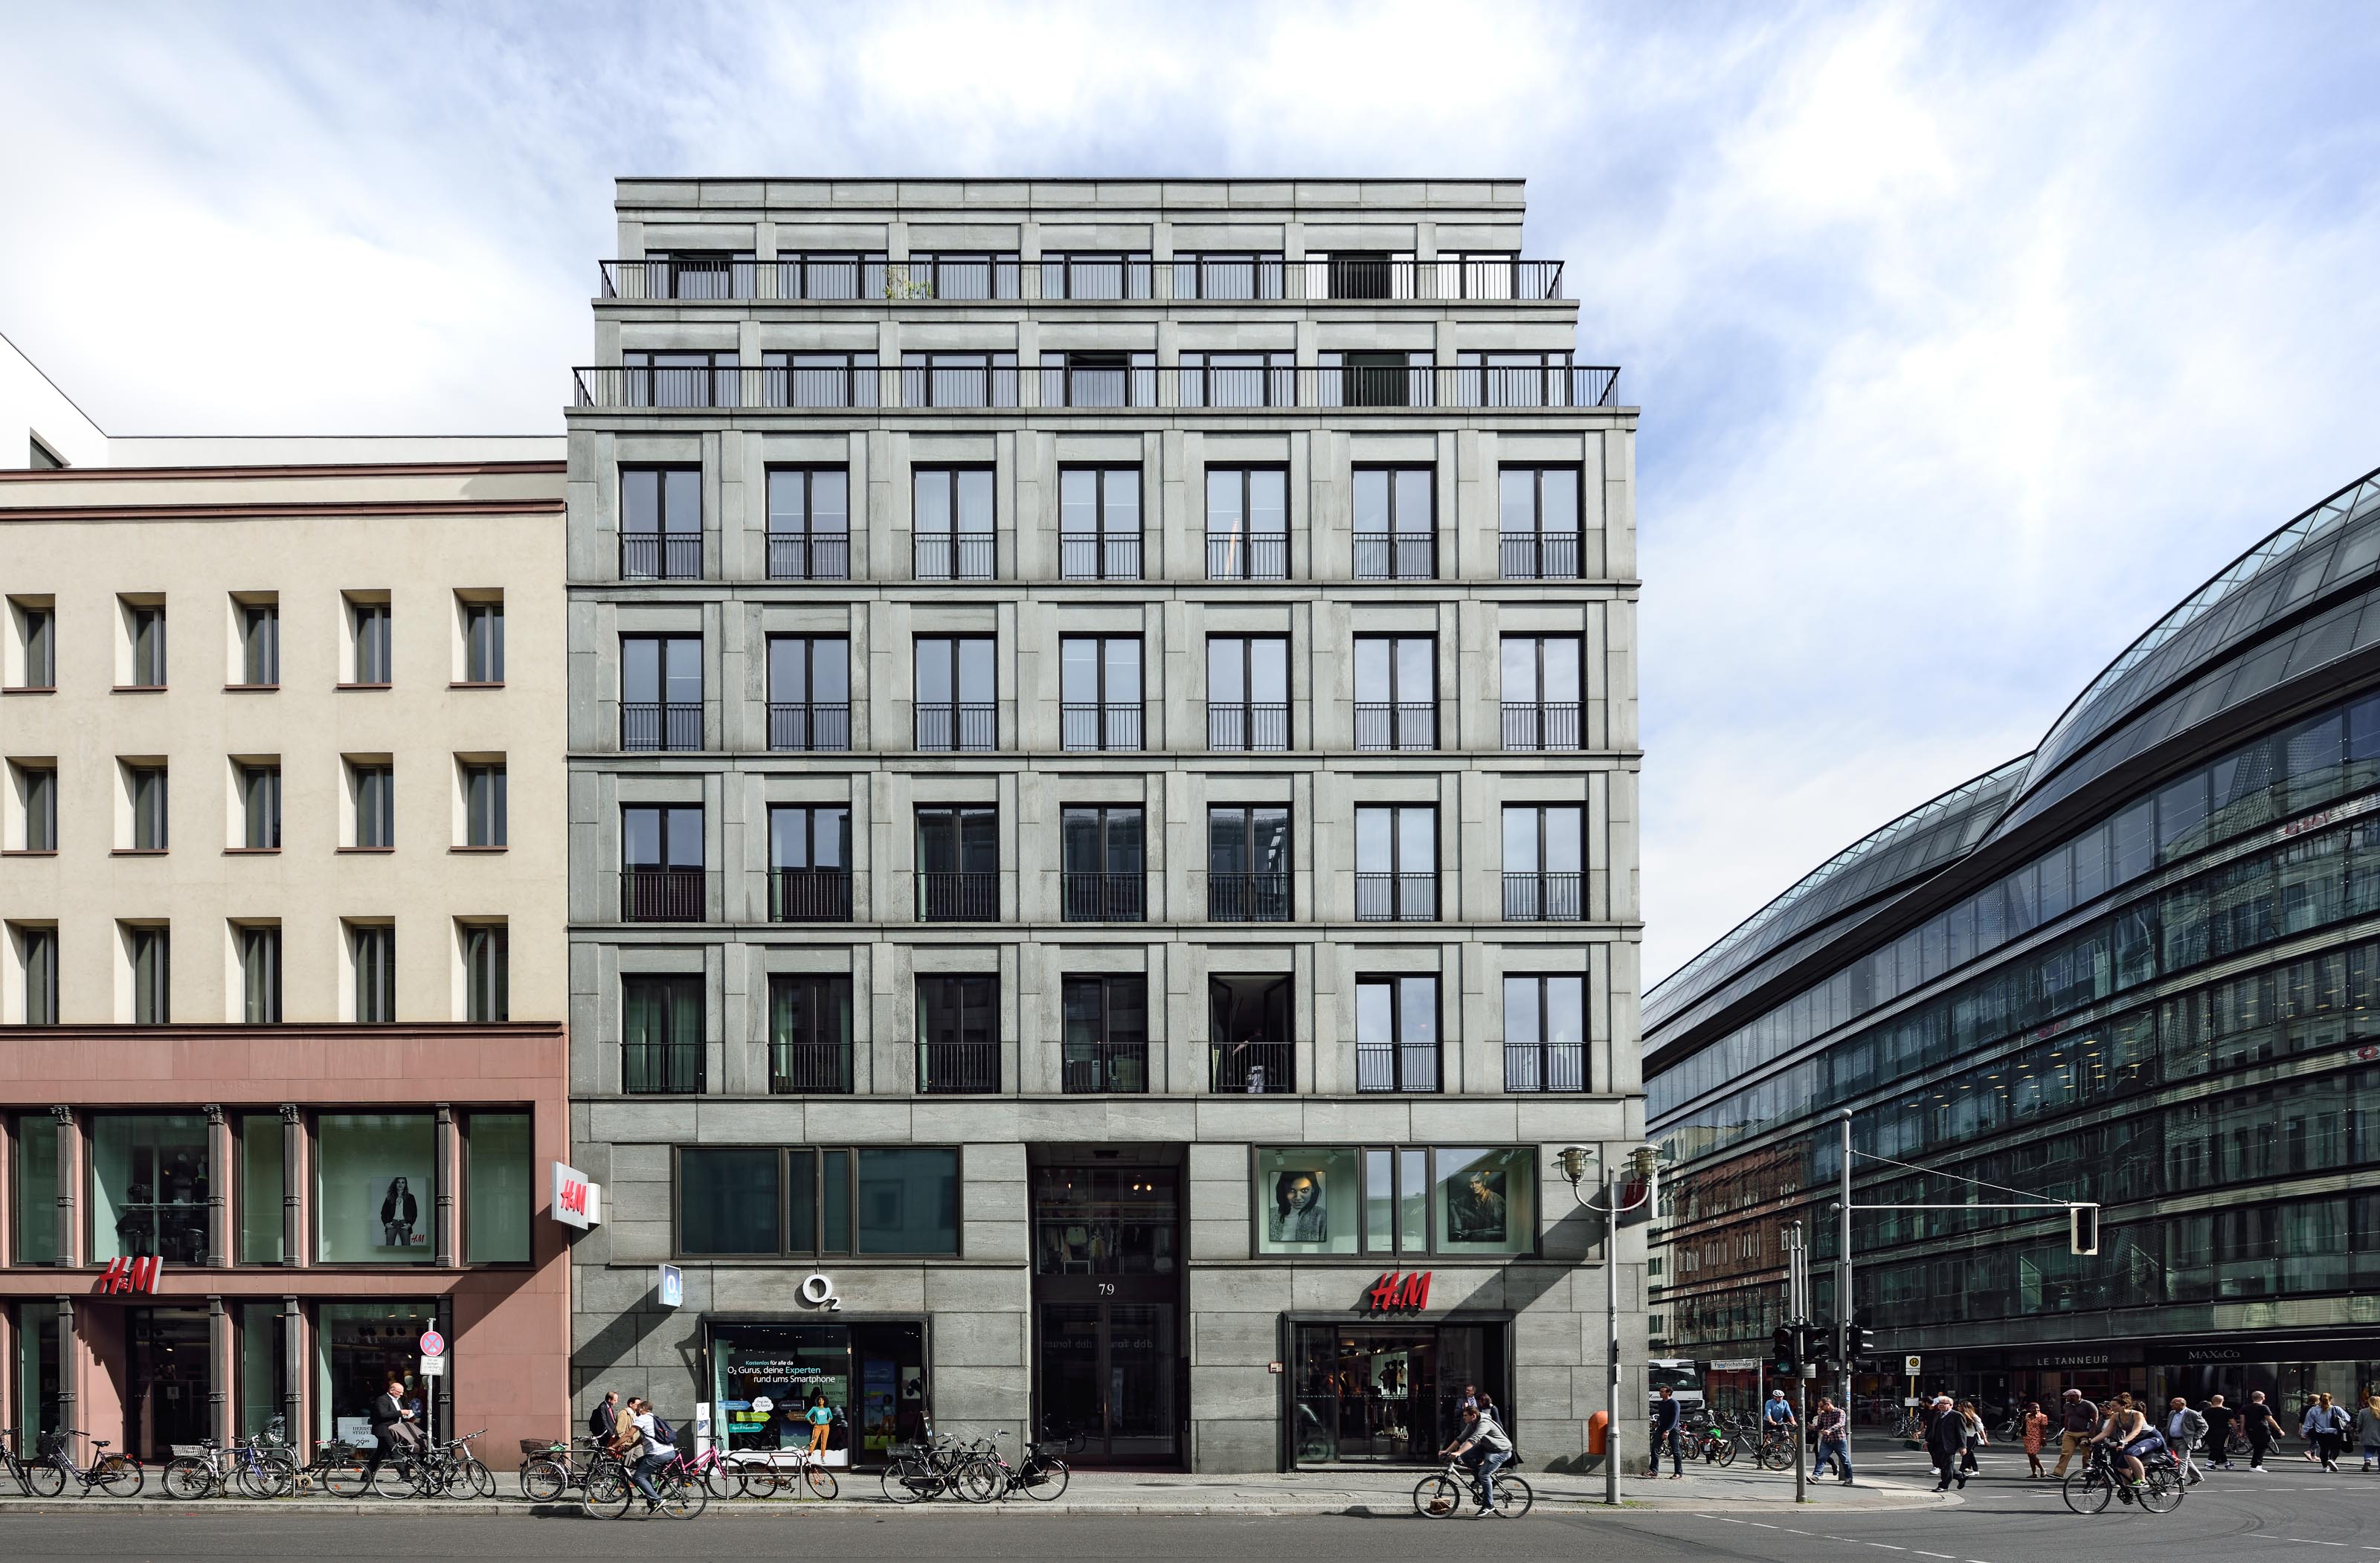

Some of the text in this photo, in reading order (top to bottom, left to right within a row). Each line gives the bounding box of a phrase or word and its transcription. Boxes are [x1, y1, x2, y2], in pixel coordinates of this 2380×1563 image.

[561, 1179, 587, 1216] H&M
[99, 1256, 161, 1295] H&M
[1099, 1283, 1115, 1295] 79
[1370, 1271, 1432, 1310] H&M
[2055, 1356, 2108, 1365] TANNEUR
[739, 1366, 762, 1375] Gurus,
[785, 1366, 820, 1375] Experten
[790, 1375, 835, 1384] Smartphone
